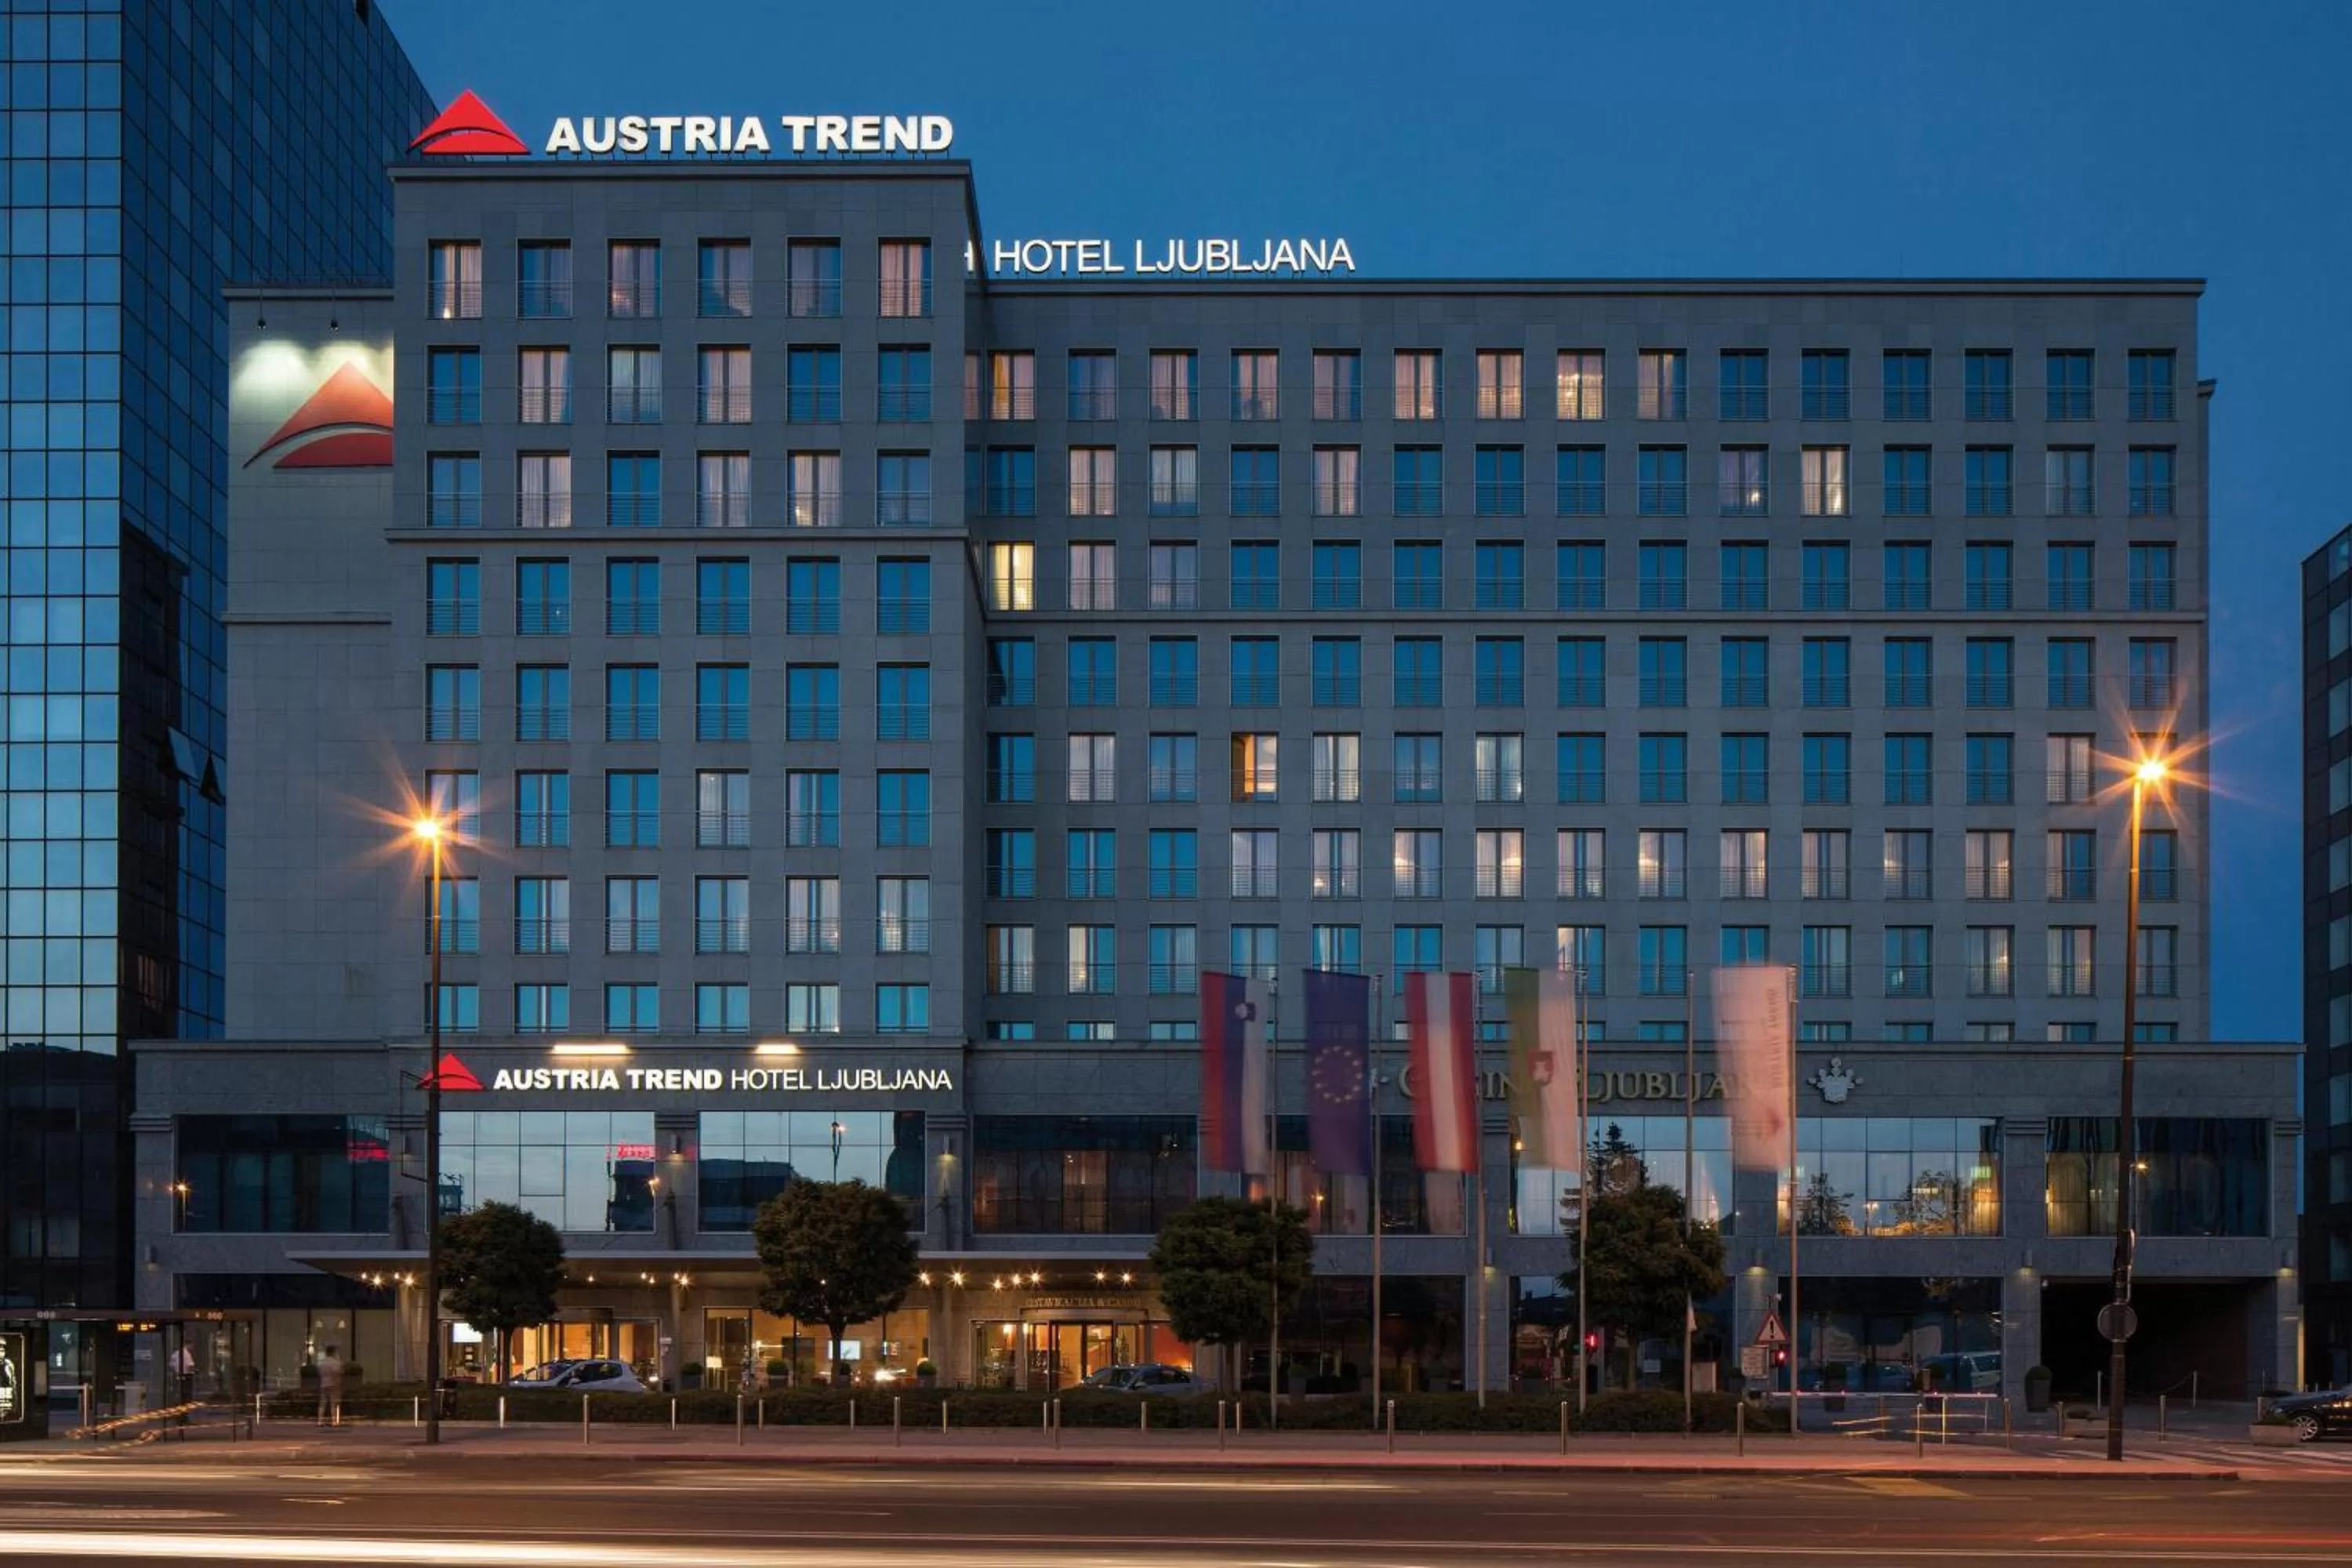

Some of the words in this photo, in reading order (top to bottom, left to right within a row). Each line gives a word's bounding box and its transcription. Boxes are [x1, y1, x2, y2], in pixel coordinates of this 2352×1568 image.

[545, 115, 771, 153] AUSTRIA
[782, 115, 954, 151] TREND
[994, 239, 1125, 273] HOTEL
[1135, 238, 1356, 273] LJUBLJANA
[493, 1068, 620, 1091] AUSTRIA
[625, 1069, 722, 1091] TREND
[731, 1068, 813, 1091] HOTEL
[818, 1068, 953, 1091] LJUBLJANA
